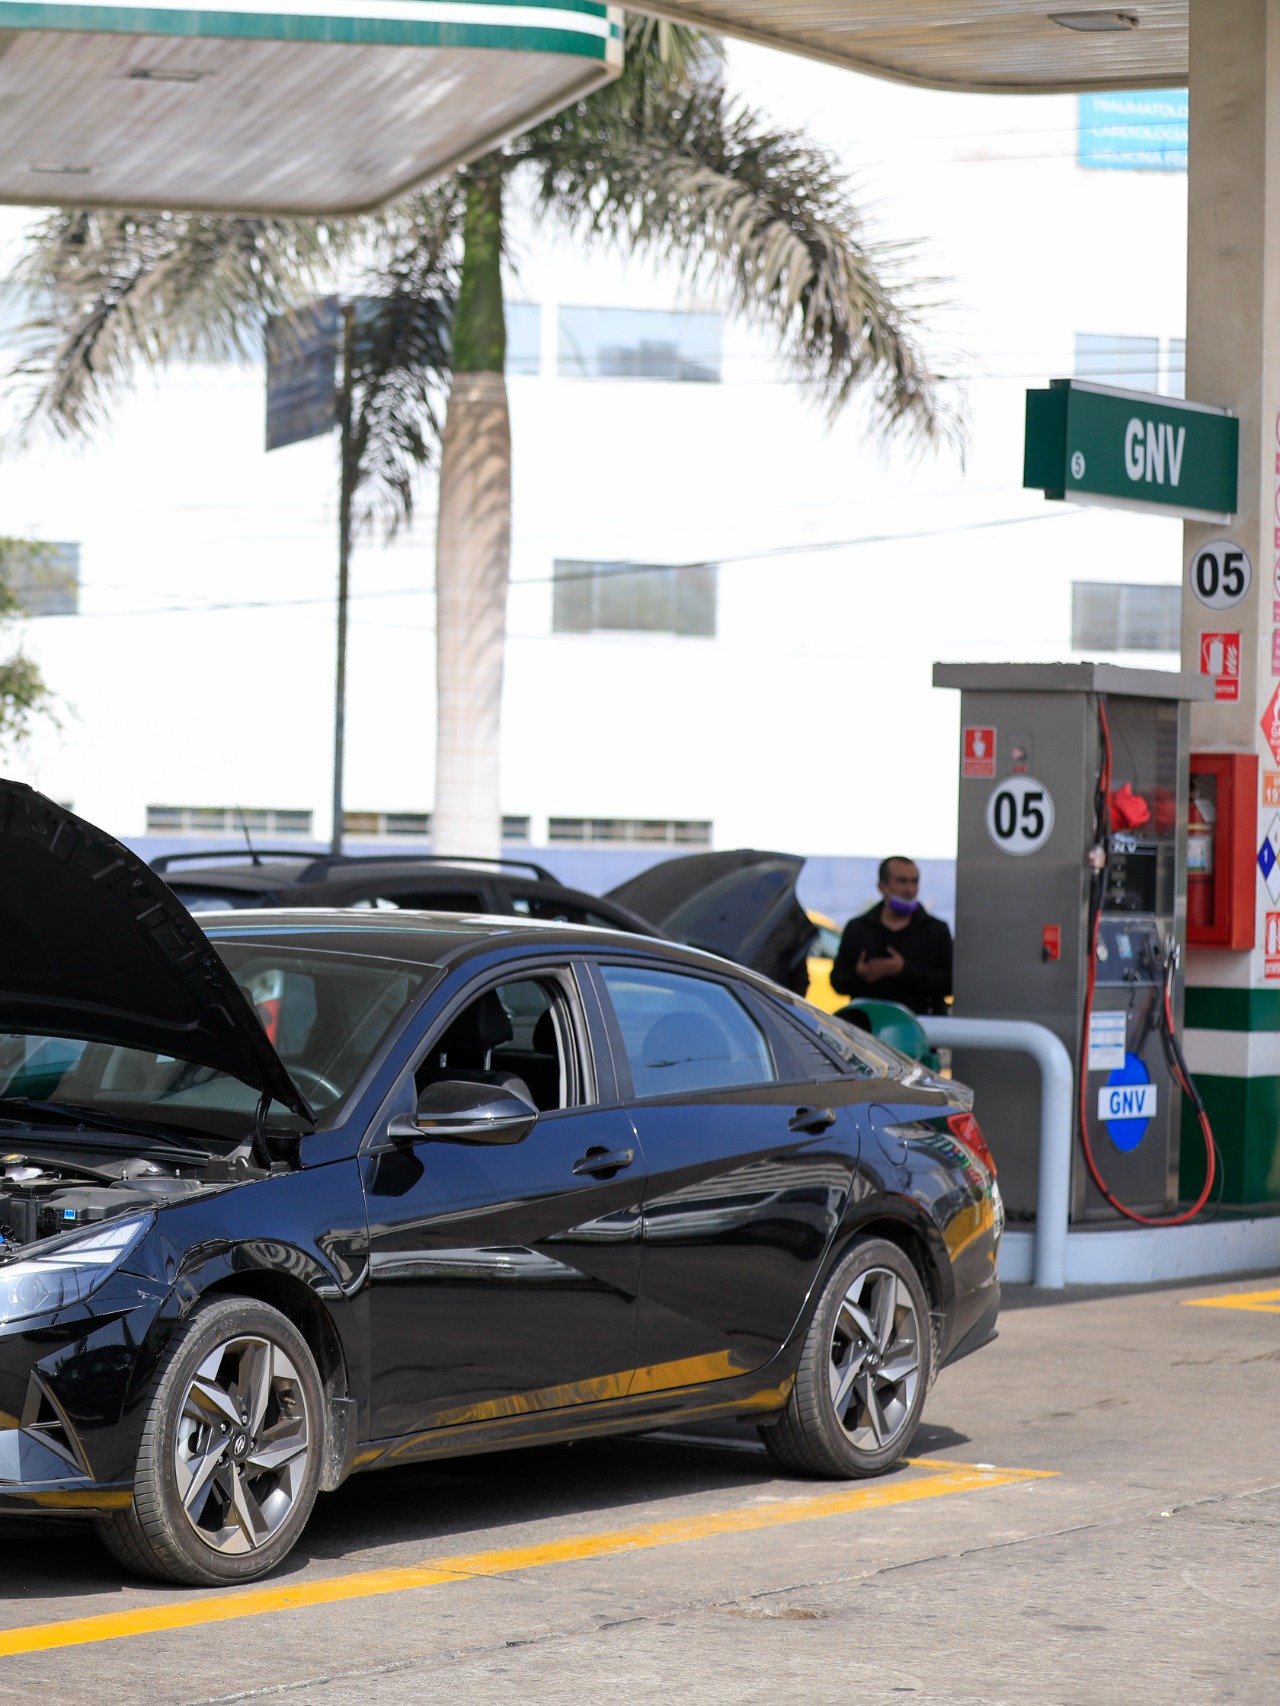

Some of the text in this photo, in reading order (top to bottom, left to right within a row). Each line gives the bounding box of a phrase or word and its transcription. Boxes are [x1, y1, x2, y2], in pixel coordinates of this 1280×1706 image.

[1092, 98, 1188, 118] TRAUMATOLO
[1074, 455, 1083, 476] 5
[1125, 417, 1186, 487] GNV
[1196, 552, 1245, 598] 05
[994, 791, 1045, 840] 05
[1110, 1089, 1146, 1115] GNV
